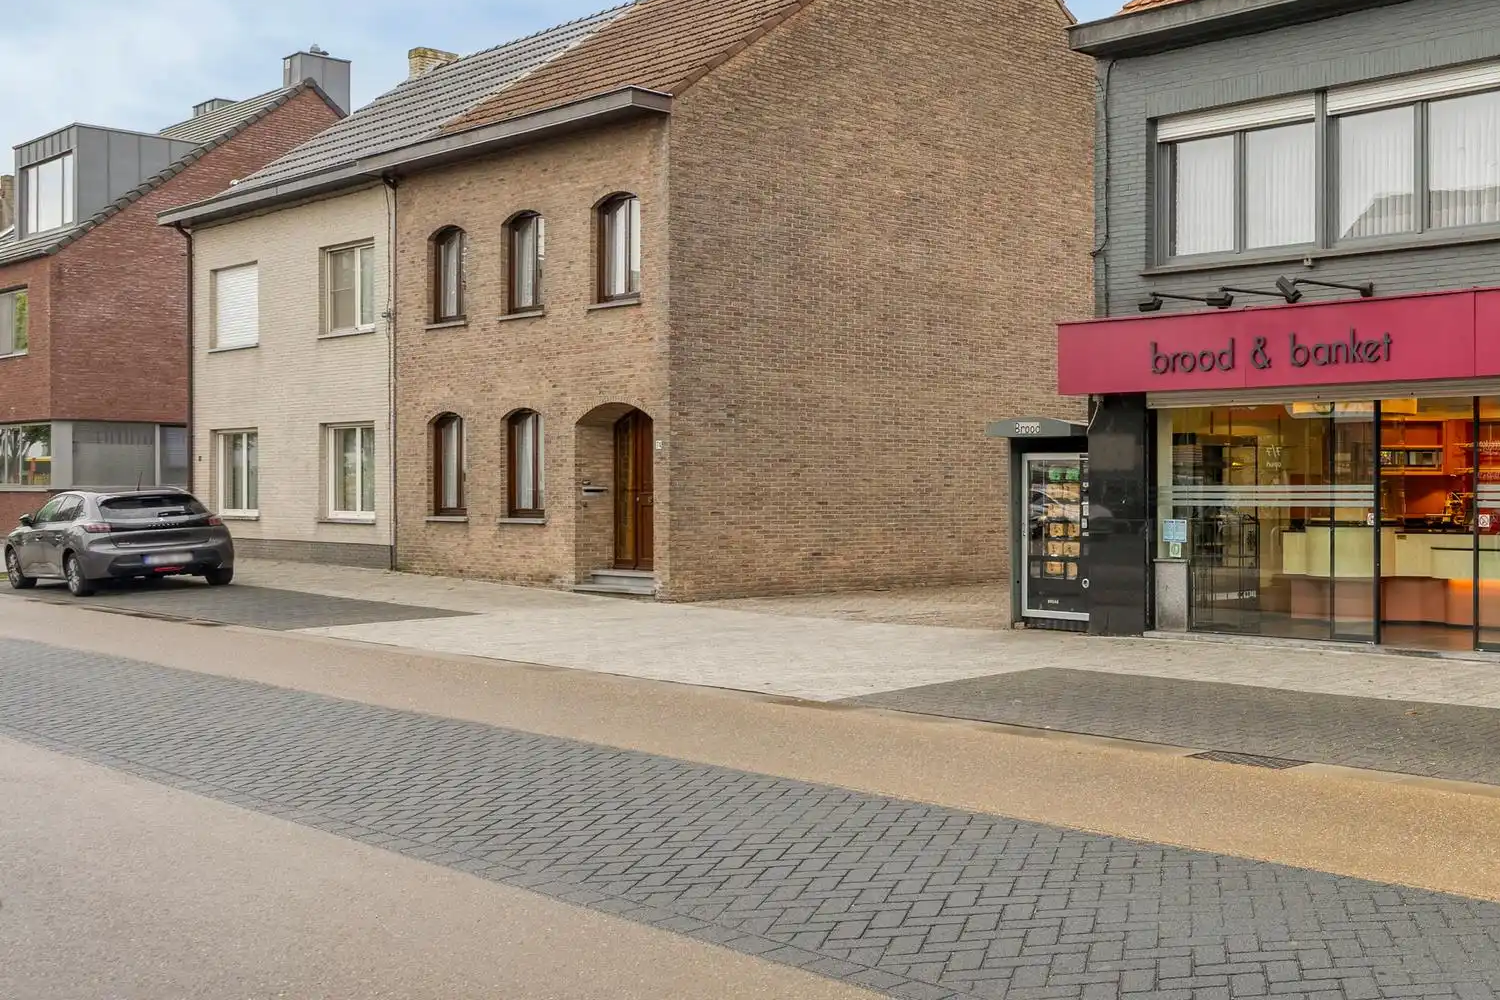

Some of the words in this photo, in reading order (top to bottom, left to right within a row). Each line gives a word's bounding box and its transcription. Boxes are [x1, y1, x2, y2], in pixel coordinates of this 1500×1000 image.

[1150, 336, 1235, 375] brood
[1251, 336, 1272, 370] &
[1289, 326, 1393, 368] banket
